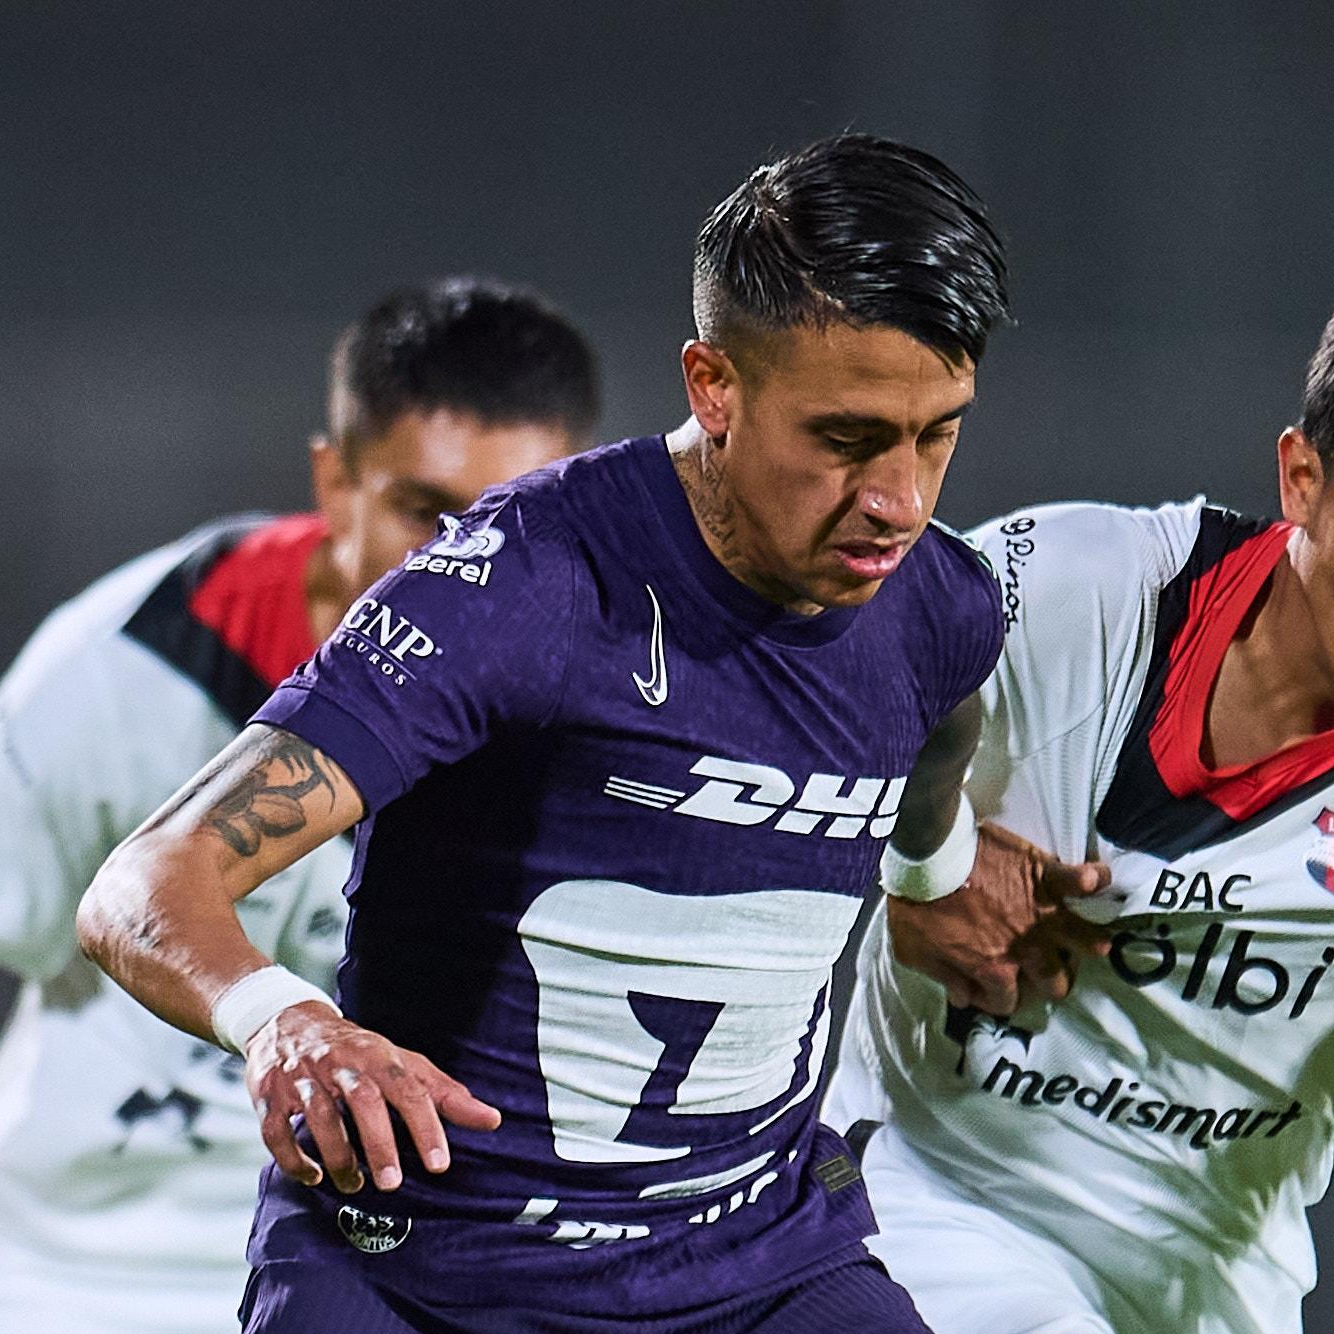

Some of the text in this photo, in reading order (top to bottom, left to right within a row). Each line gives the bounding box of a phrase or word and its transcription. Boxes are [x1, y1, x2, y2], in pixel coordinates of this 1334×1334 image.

[405, 555, 492, 587] Berel
[343, 598, 435, 662] GNP
[1149, 868, 1252, 912] BAC
[981, 1055, 1301, 1150] medismart
